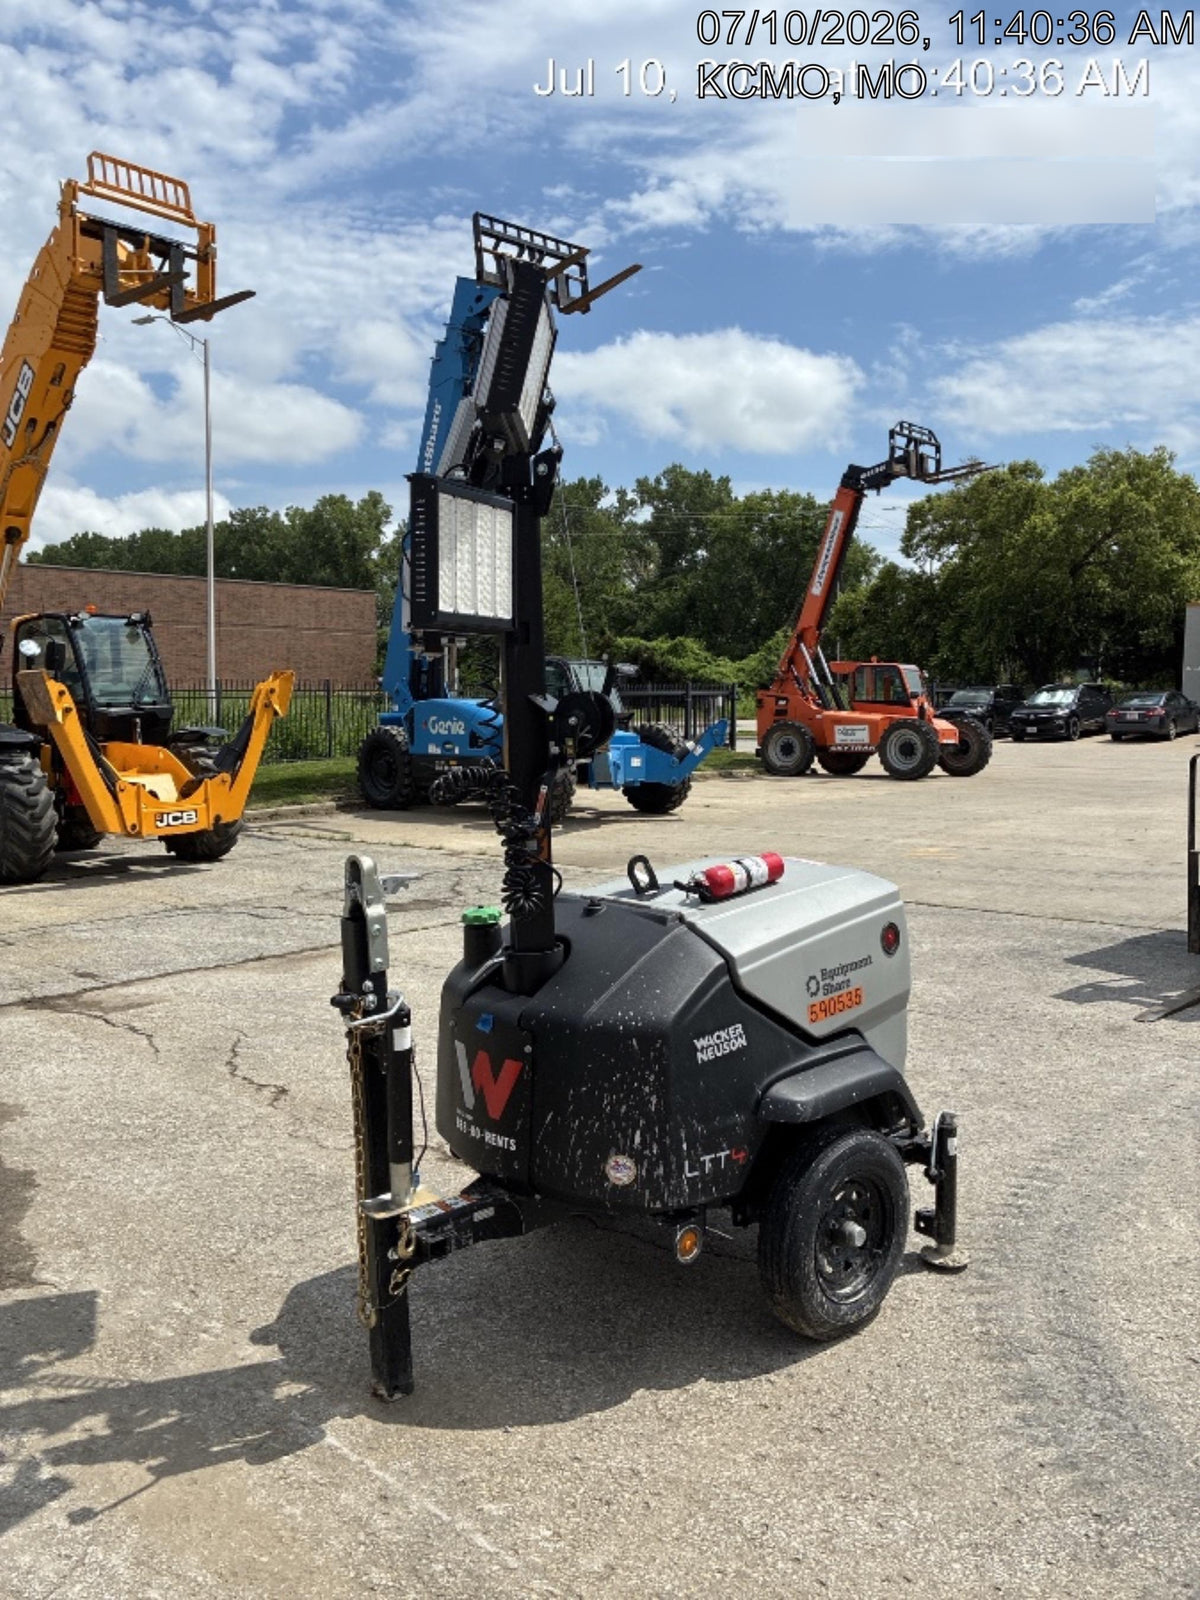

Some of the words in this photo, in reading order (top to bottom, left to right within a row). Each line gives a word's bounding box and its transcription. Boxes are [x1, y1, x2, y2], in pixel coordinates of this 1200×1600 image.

[5, 363, 35, 447] JCB
[428, 716, 465, 735] Genie
[156, 810, 196, 828] JCB
[821, 954, 873, 982] Equipment
[822, 978, 851, 996] Share
[809, 987, 862, 1023] 590535
[693, 1023, 744, 1050] WACKER
[696, 1034, 747, 1064] NEUSON
